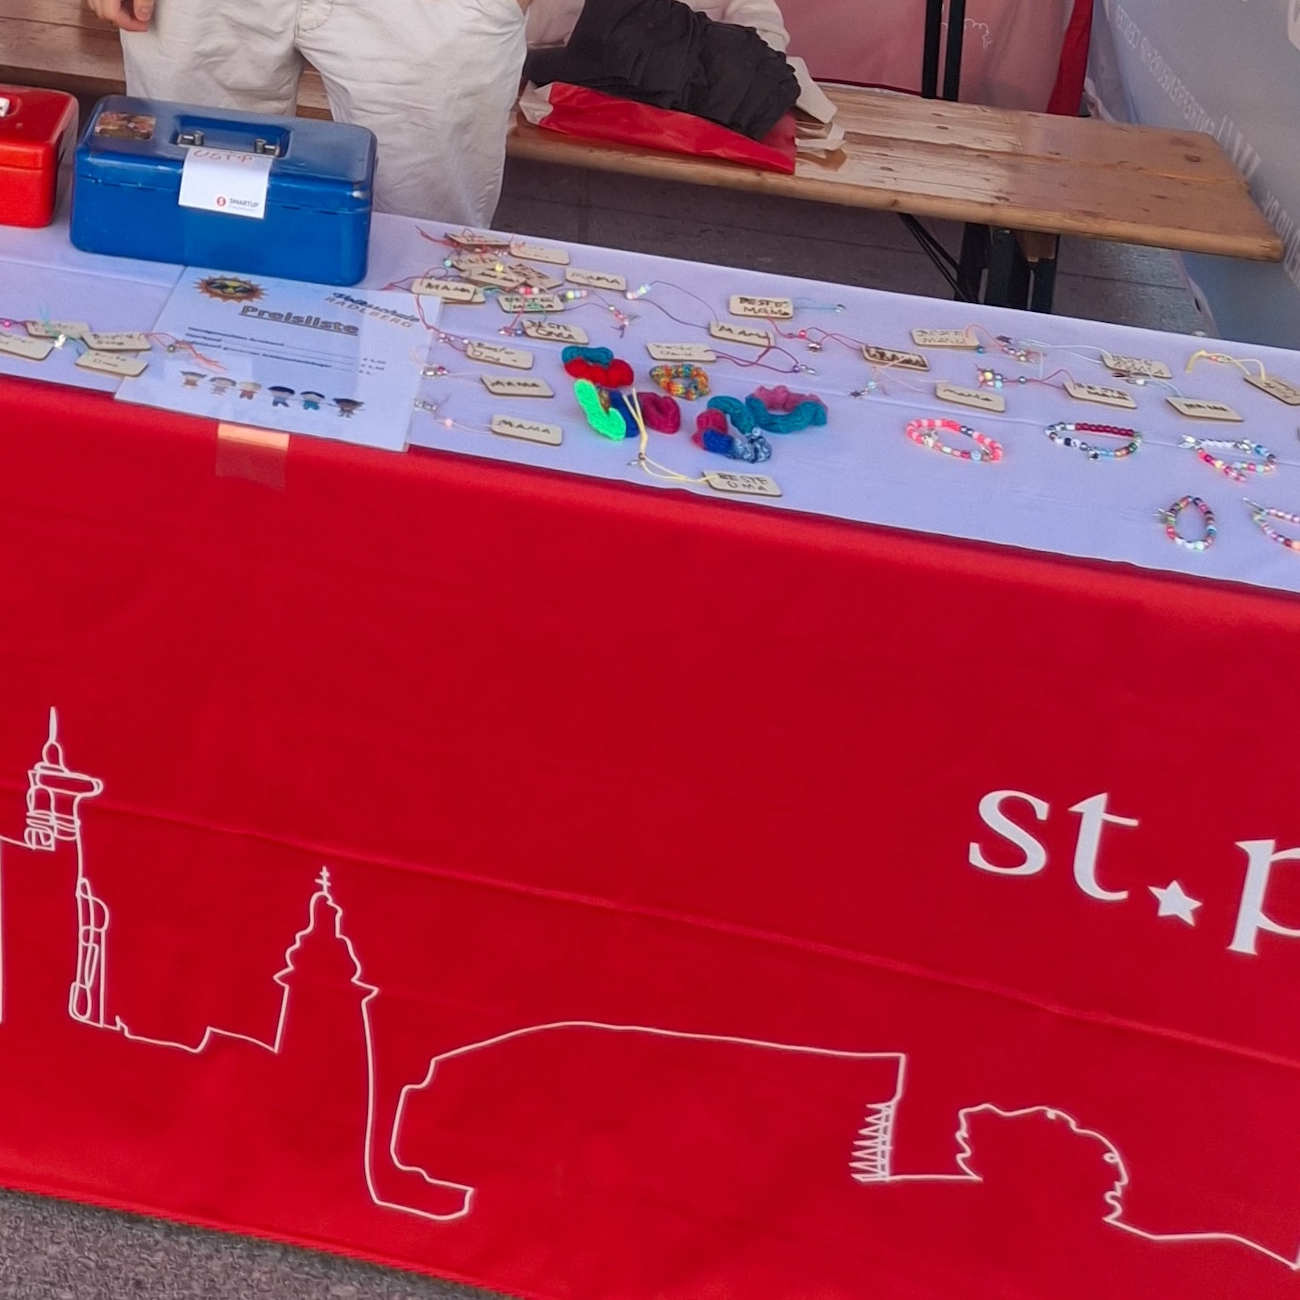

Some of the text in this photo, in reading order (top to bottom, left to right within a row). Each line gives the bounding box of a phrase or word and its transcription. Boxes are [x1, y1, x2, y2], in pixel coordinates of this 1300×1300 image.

[228, 197, 260, 208] SMARTUP
[238, 304, 361, 334] Preisliste
[324, 296, 414, 329] RADLBERG
